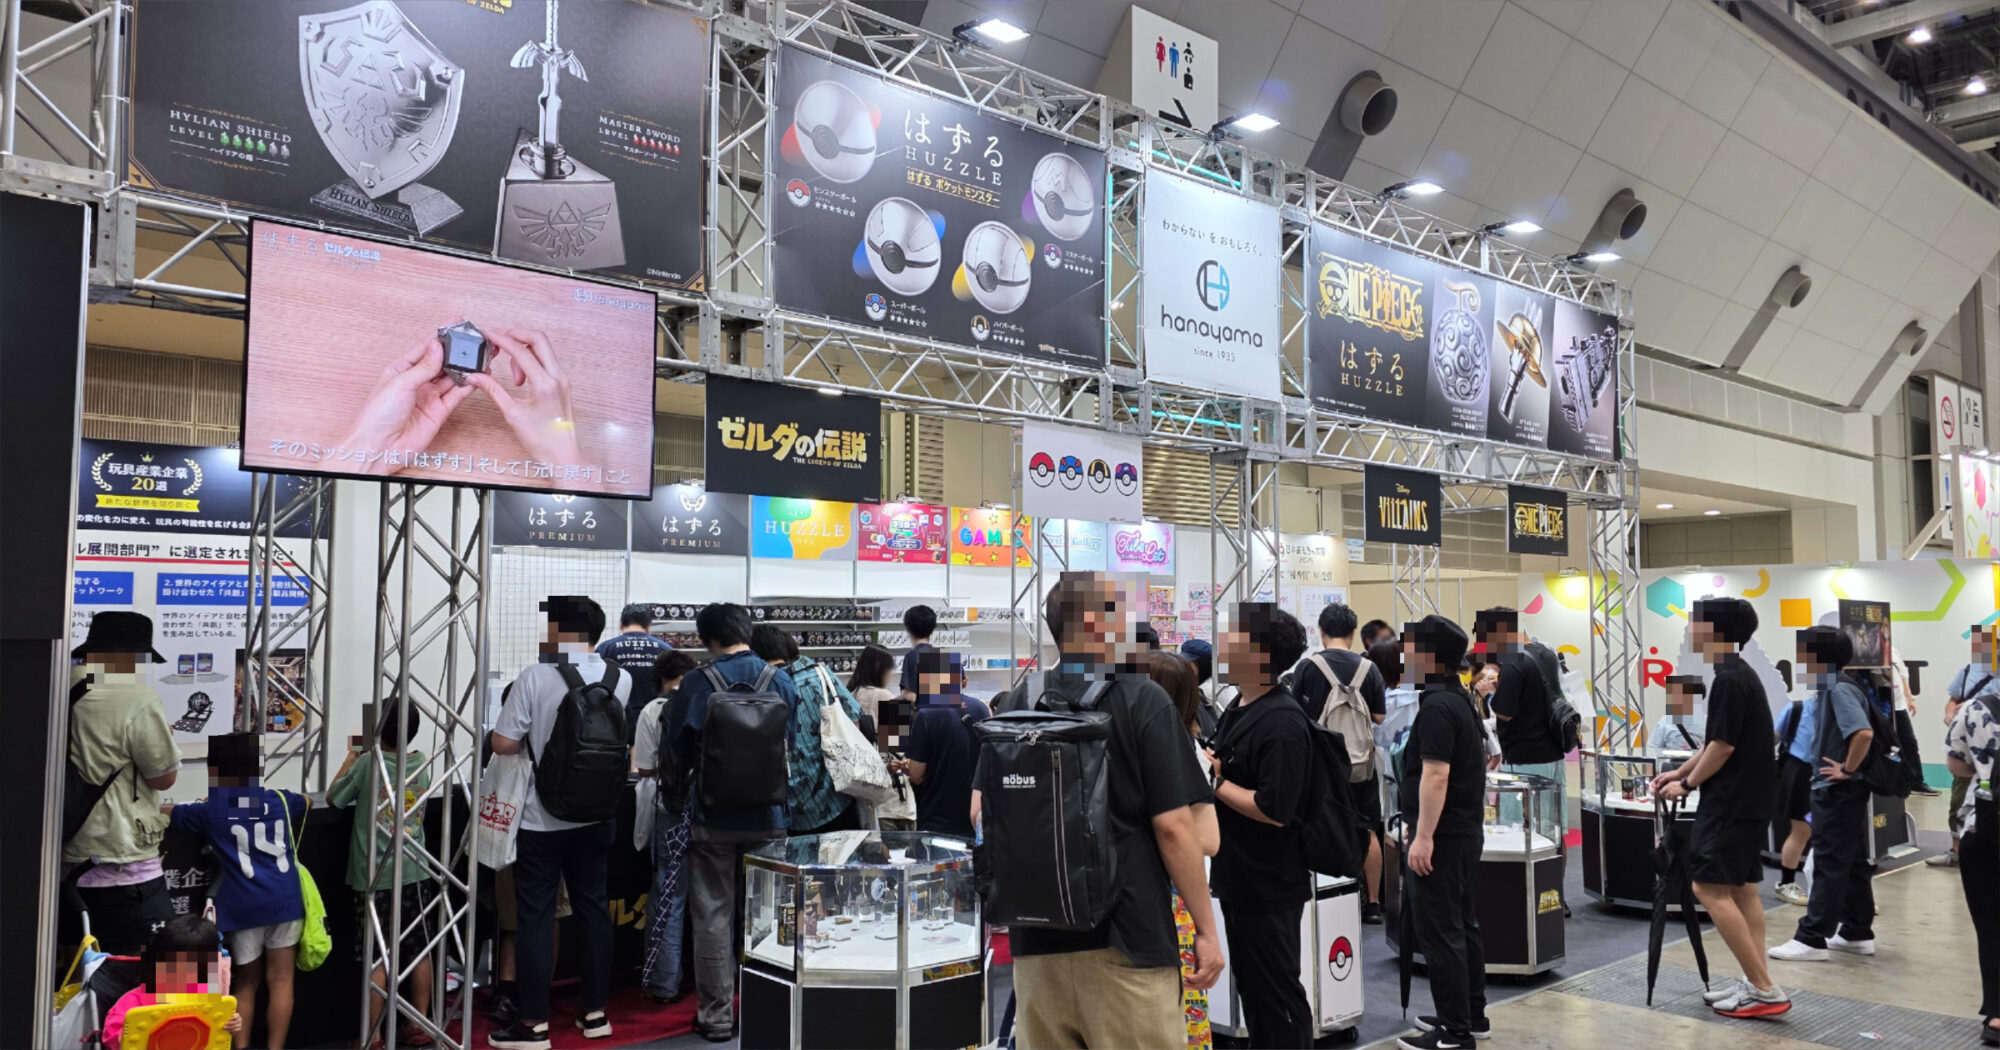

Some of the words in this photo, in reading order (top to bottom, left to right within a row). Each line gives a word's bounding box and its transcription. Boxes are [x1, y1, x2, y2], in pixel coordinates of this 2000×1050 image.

[169, 124, 215, 140] LEVEL
[170, 109, 230, 130] HYLIAN
[236, 124, 292, 143] SHIELD
[599, 115, 642, 133] MASTER
[646, 128, 681, 143] SWORD
[599, 127, 629, 140] LEVEL
[905, 107, 1004, 168] はずる
[905, 145, 1002, 187] HUZZLE
[907, 169, 932, 187] はずる
[936, 178, 1001, 204] ポケットモンスター
[329, 189, 370, 210] HYLIAN
[371, 203, 411, 222] SHIELD
[1162, 219, 1206, 240] わからない
[1209, 232, 1216, 245] を
[1220, 236, 1263, 257] おもしろく。
[1319, 260, 1371, 319] ONE
[1371, 274, 1424, 333] PIECE
[1161, 304, 1263, 348] hanayama
[1193, 346, 1214, 359] since
[1217, 349, 1236, 362] 1933
[1340, 340, 1405, 381] はずる
[1340, 372, 1404, 397] HUZZLE
[717, 416, 868, 462] ゼルダの伝説
[107, 462, 188, 480] 玩具産業企業
[268, 437, 632, 485] そのミッションは「はずす」そして「元に戻す」こと
[792, 457, 806, 465] THE
[808, 458, 832, 467] LEGEND
[843, 462, 862, 470] ZELDA
[131, 476, 168, 492] 20選
[529, 507, 597, 530] はずる
[661, 516, 722, 536] はずる
[1378, 495, 1429, 532] VILLAINS
[1539, 509, 1564, 537] PIECE
[529, 531, 596, 542] PREMIUM
[764, 520, 845, 537] HUZZLE
[662, 538, 722, 548] PREMIUM
[615, 640, 660, 648] HUZZLE
[1002, 773, 1036, 786] möbus
[230, 819, 290, 879] 14
